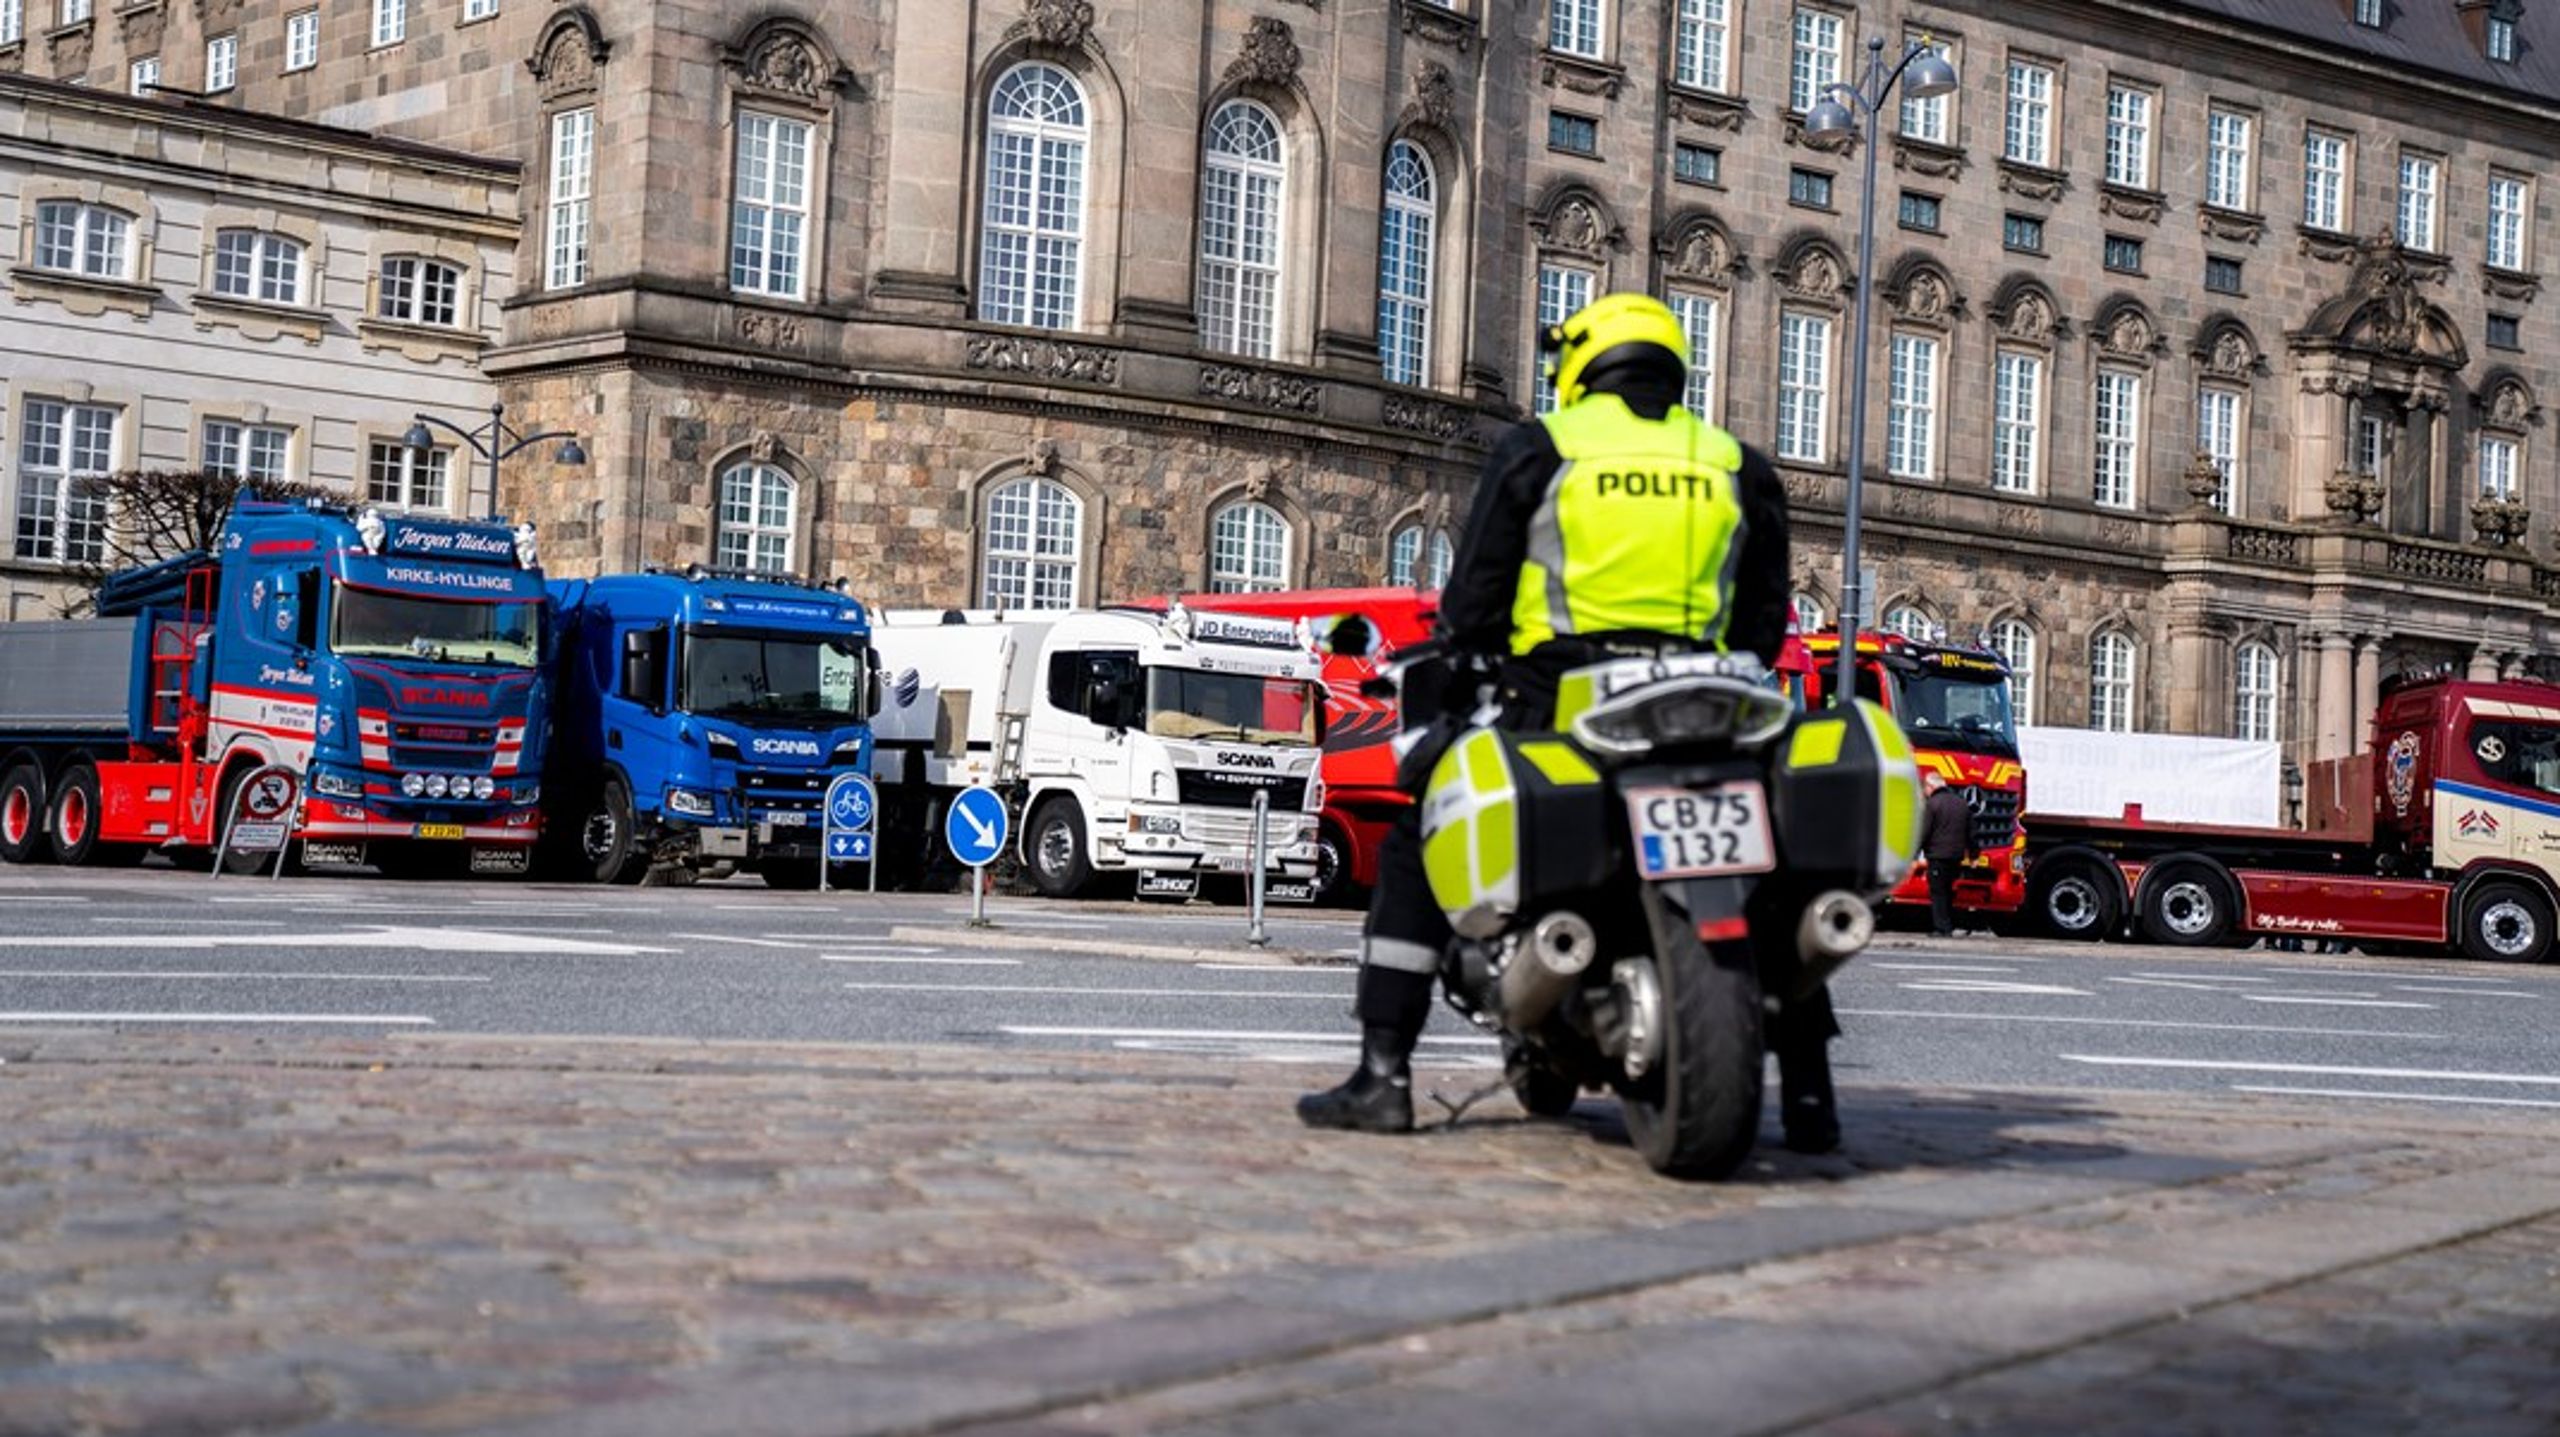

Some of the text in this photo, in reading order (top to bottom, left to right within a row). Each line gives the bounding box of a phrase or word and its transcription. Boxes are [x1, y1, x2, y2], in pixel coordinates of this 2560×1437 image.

[1597, 472, 1712, 501] POLITI
[455, 532, 510, 554] Nielsen
[386, 567, 513, 591] KIRKE-HYLLINGE
[1199, 621, 1292, 641] JD Entreprise
[402, 687, 489, 709] SCANIA
[753, 738, 819, 756] SCANIA
[1217, 751, 1275, 769] SCANIA
[1673, 831, 1742, 866] 132
